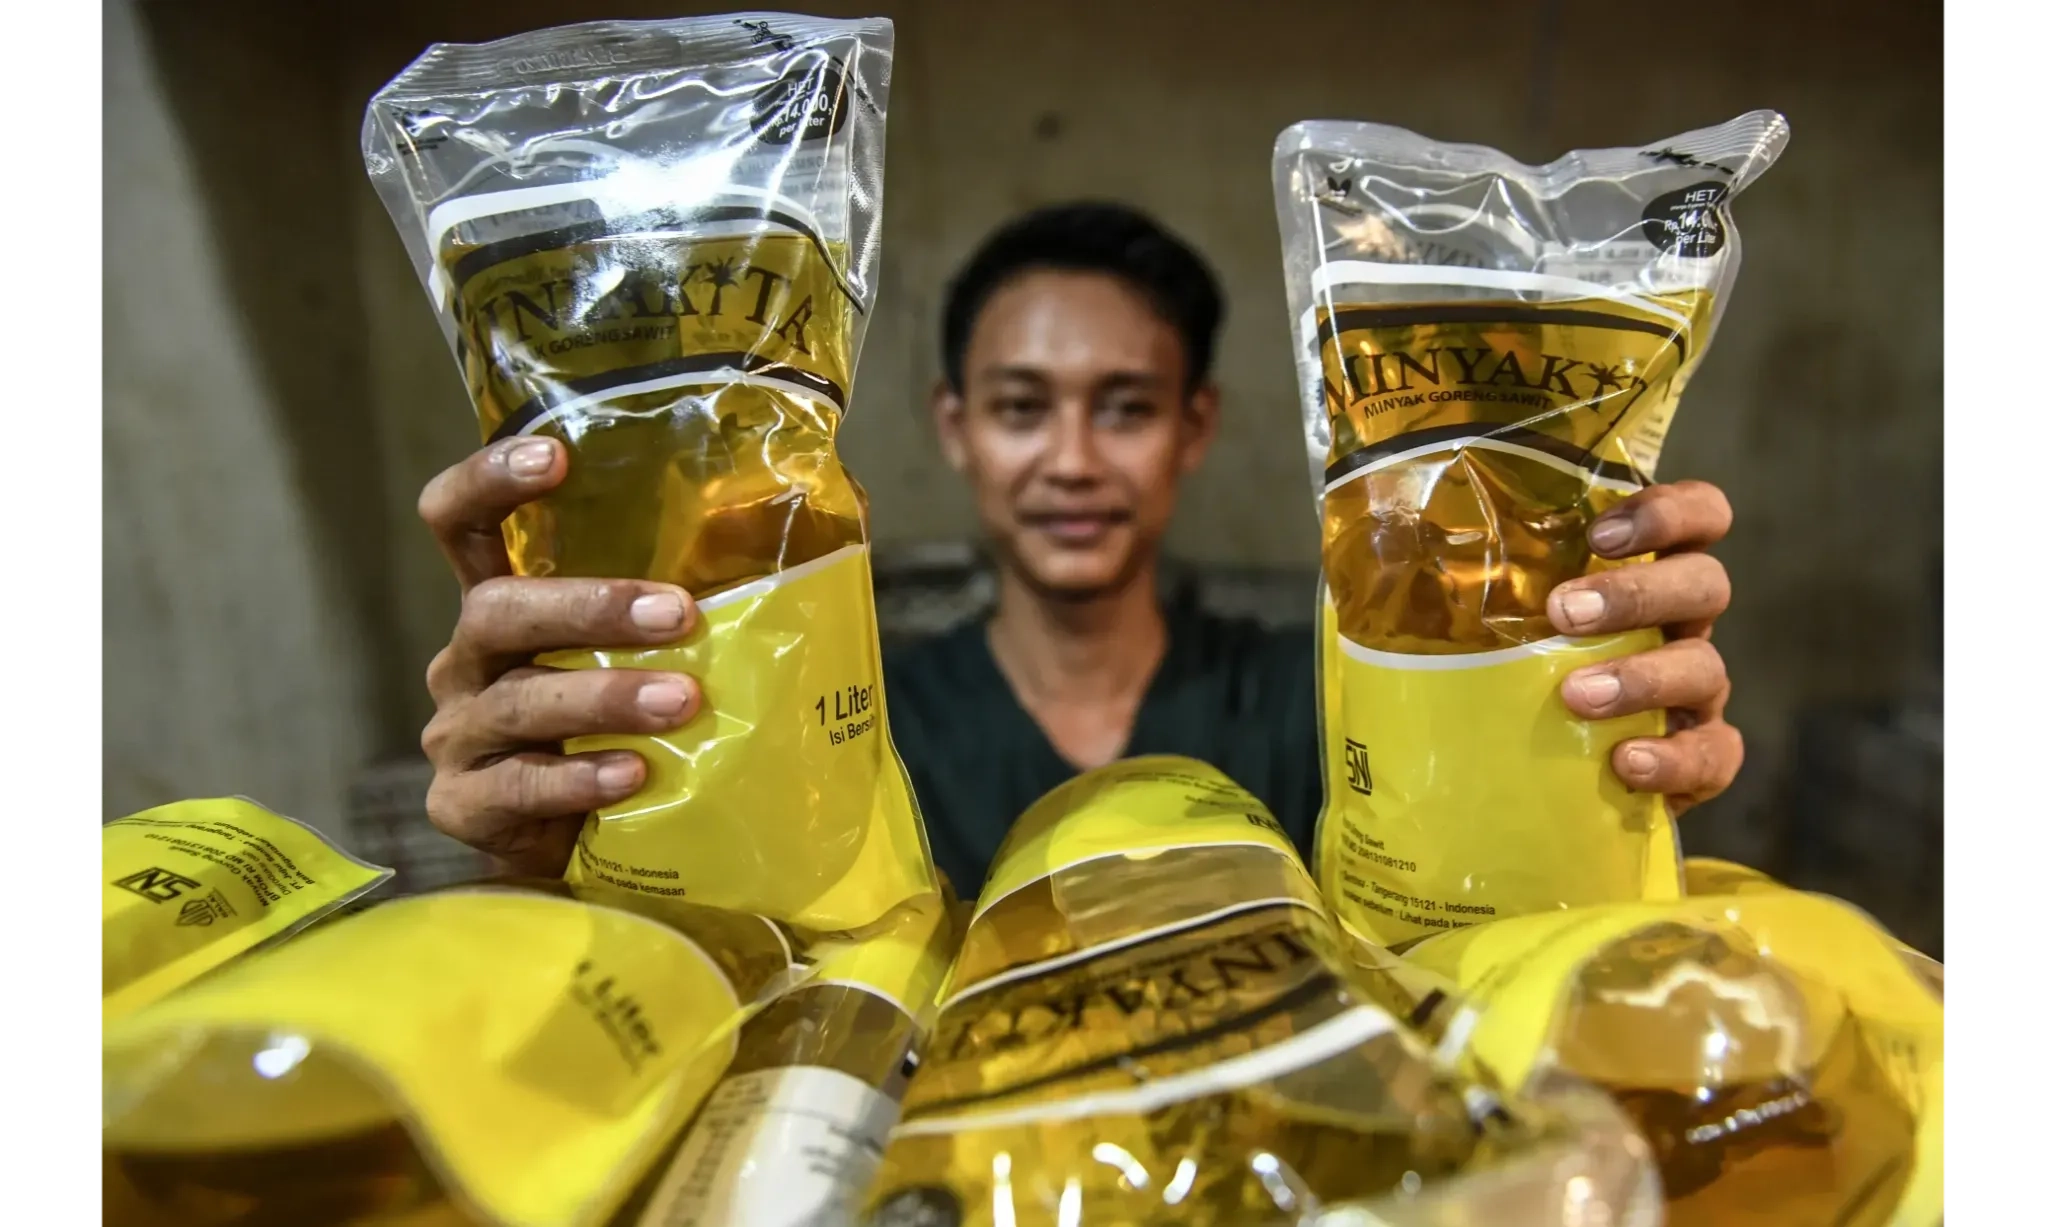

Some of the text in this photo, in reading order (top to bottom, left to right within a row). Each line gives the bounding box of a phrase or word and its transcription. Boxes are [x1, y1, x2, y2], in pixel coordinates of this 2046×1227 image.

[1685, 189, 1717, 203] HET
[1676, 233, 1696, 246] per
[551, 327, 620, 355] GORENG
[624, 324, 675, 341] SAWIT
[1364, 394, 1426, 419] MINYAK
[1428, 389, 1496, 402] GORENG
[815, 684, 874, 726] 1 Liter
[829, 726, 846, 746] Isi
[1345, 737, 1373, 796] SNI
[201, 853, 241, 876] Goreng
[225, 853, 245, 865] MD
[255, 836, 297, 871] digunakan
[295, 869, 315, 885] Baik
[630, 866, 680, 880] Indonesia
[241, 874, 270, 907] Minyak
[253, 872, 281, 902] BPOM
[640, 882, 686, 896] kemasan
[1371, 881, 1409, 907] Tangerang
[1410, 897, 1436, 911] 15121
[1445, 901, 1496, 916] Indonesia
[1400, 910, 1422, 925] Lihat
[1424, 918, 1450, 930] pada
